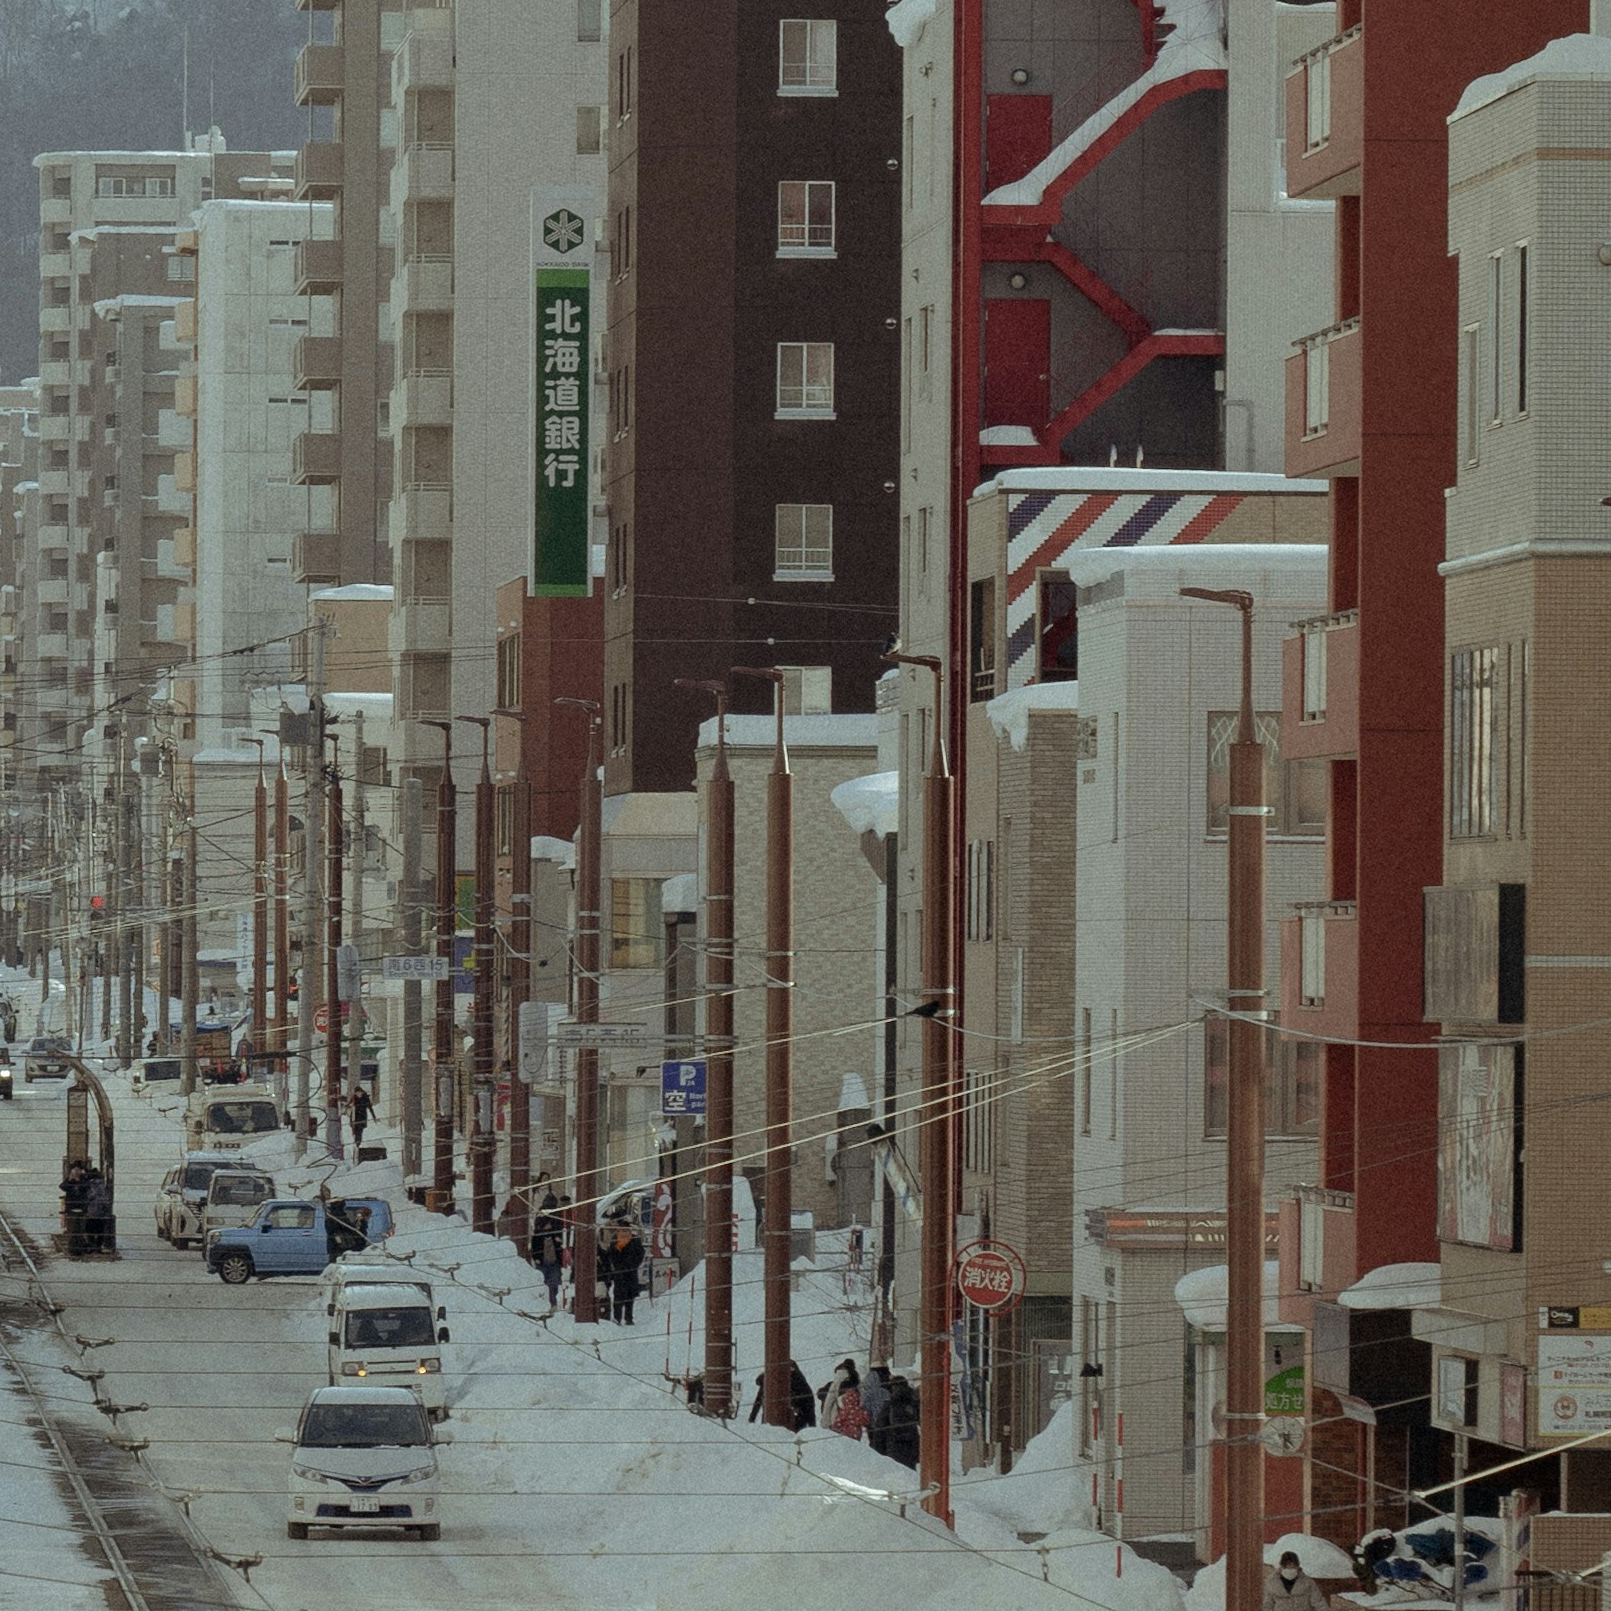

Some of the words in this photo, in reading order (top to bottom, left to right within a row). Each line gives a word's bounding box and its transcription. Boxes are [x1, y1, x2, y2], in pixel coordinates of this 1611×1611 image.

[544, 299, 581, 487] 北海道銀行
[679, 1064, 697, 1086] P
[664, 1089, 686, 1111] 空
[964, 1267, 1011, 1292] 消火栓
